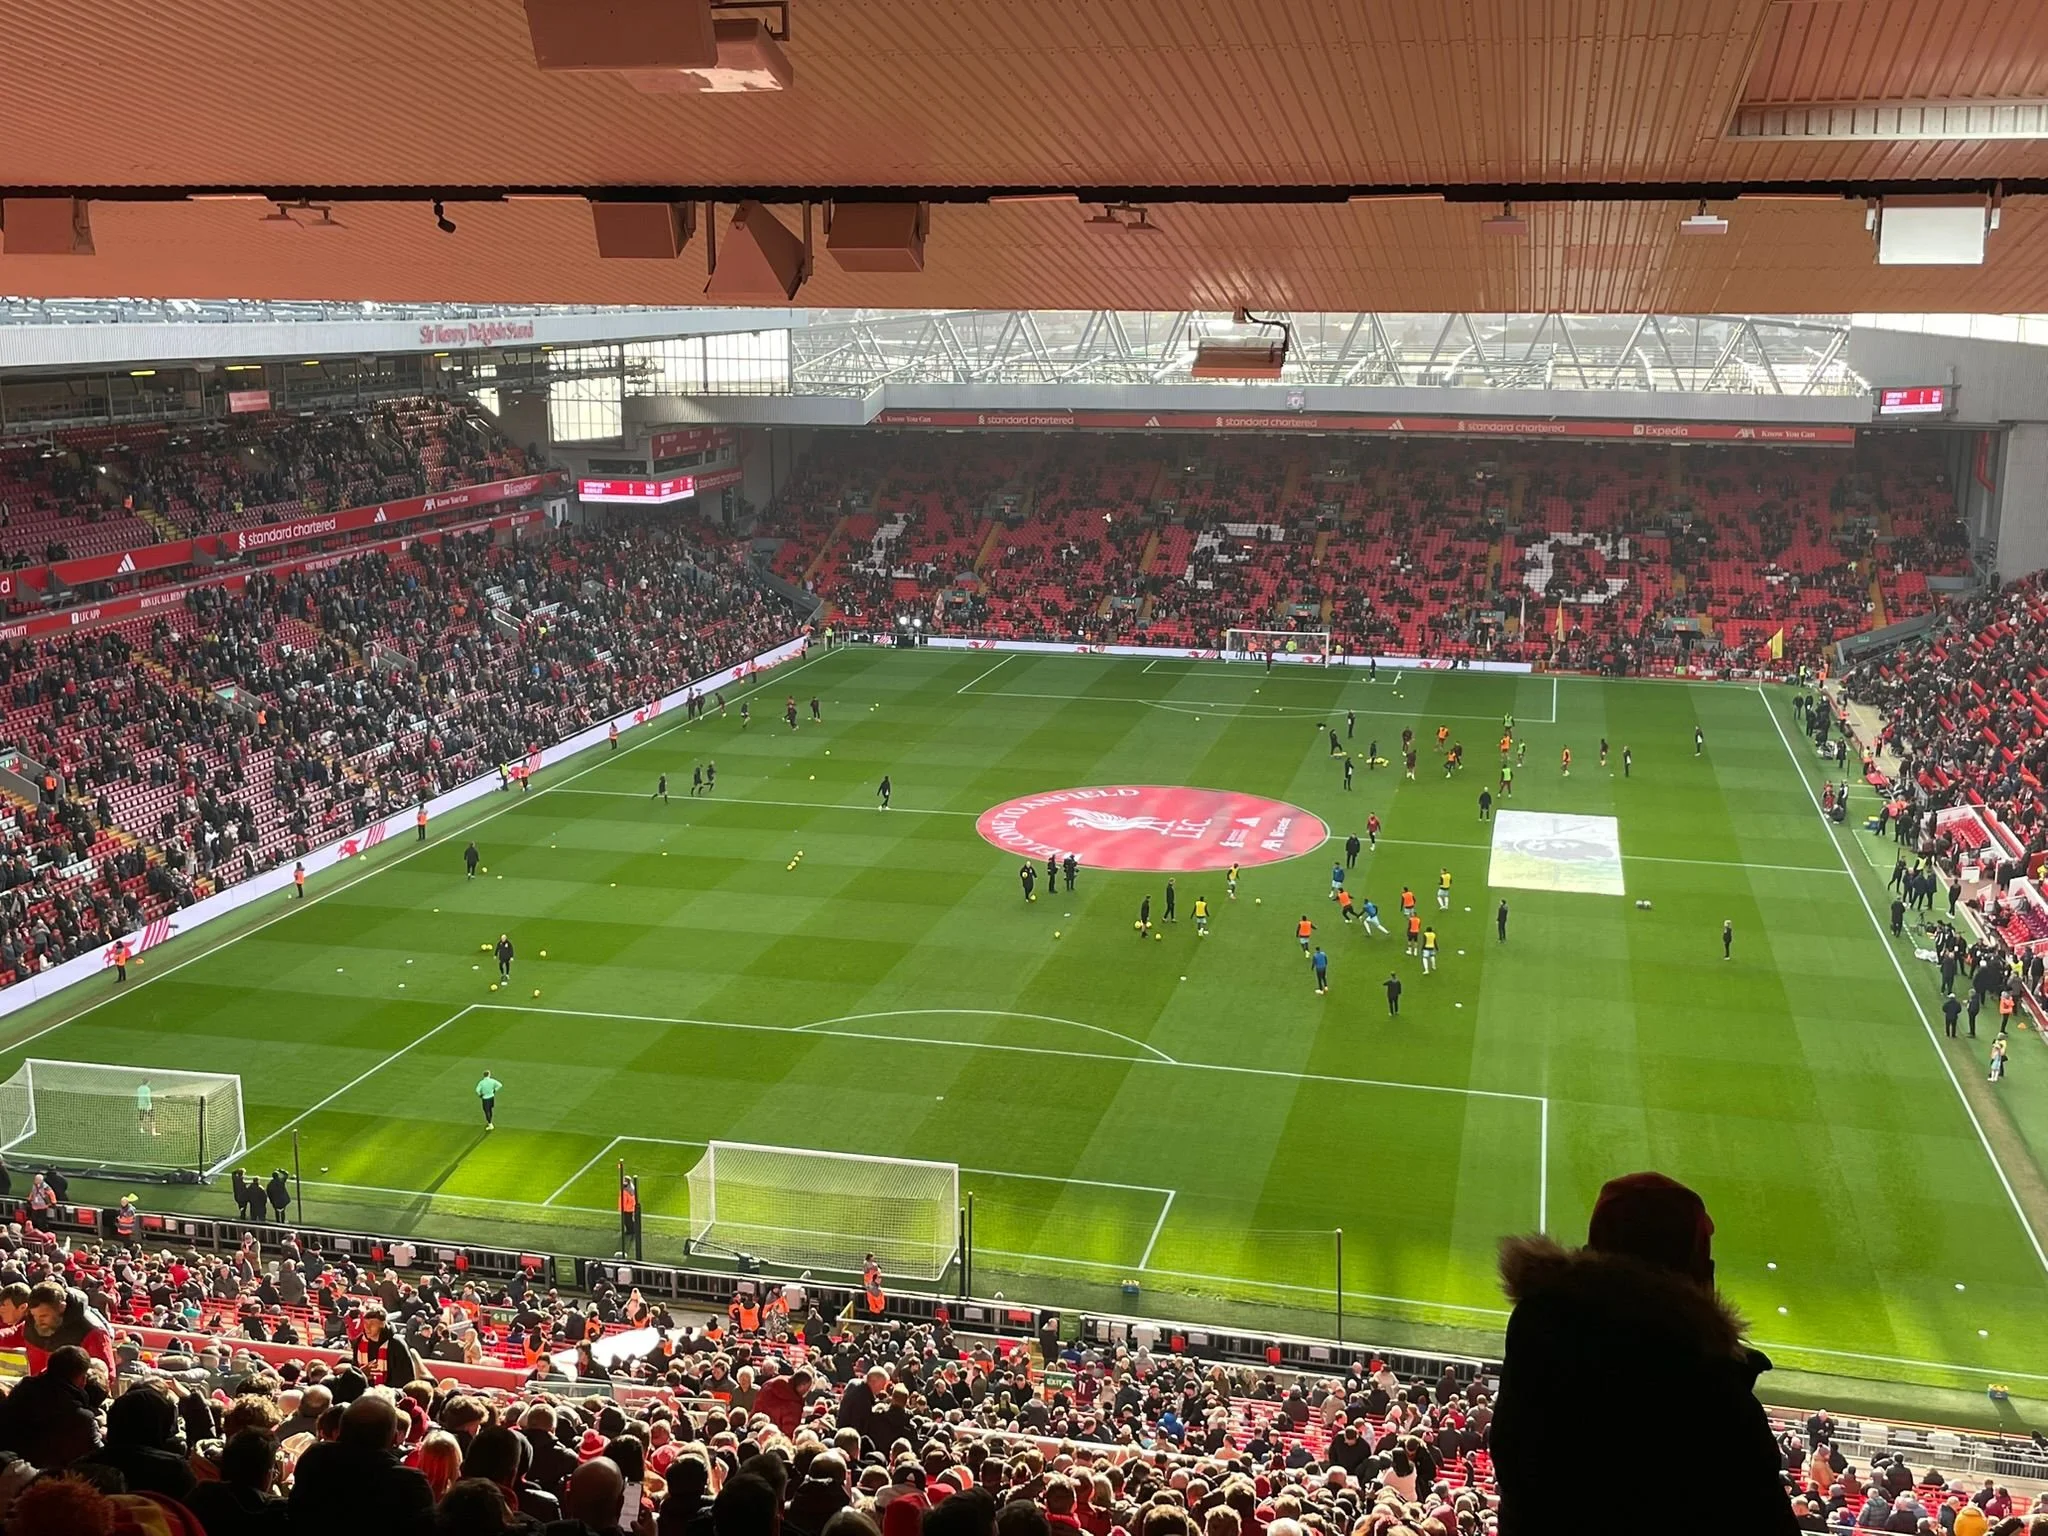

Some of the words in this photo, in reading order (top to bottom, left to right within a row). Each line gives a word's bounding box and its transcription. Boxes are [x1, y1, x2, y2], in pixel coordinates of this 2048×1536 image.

[987, 416, 1028, 425] standard
[1030, 416, 1074, 425] chartered
[1225, 417, 1268, 427] standard
[1270, 418, 1318, 428] chartered
[1467, 422, 1513, 432] standard
[1515, 423, 1565, 433] chartered
[1645, 425, 1688, 437] Expedia
[1761, 430, 1783, 438] Know
[1785, 430, 1800, 438] You
[1801, 431, 1816, 439] Can
[248, 523, 292, 546] standard
[293, 516, 336, 537] chartered
[80, 611, 89, 622] LFC
[90, 609, 101, 620] APP
[995, 807, 1029, 819] TO
[1020, 788, 1140, 810] ANFIELD
[1170, 818, 1213, 840] LFC
